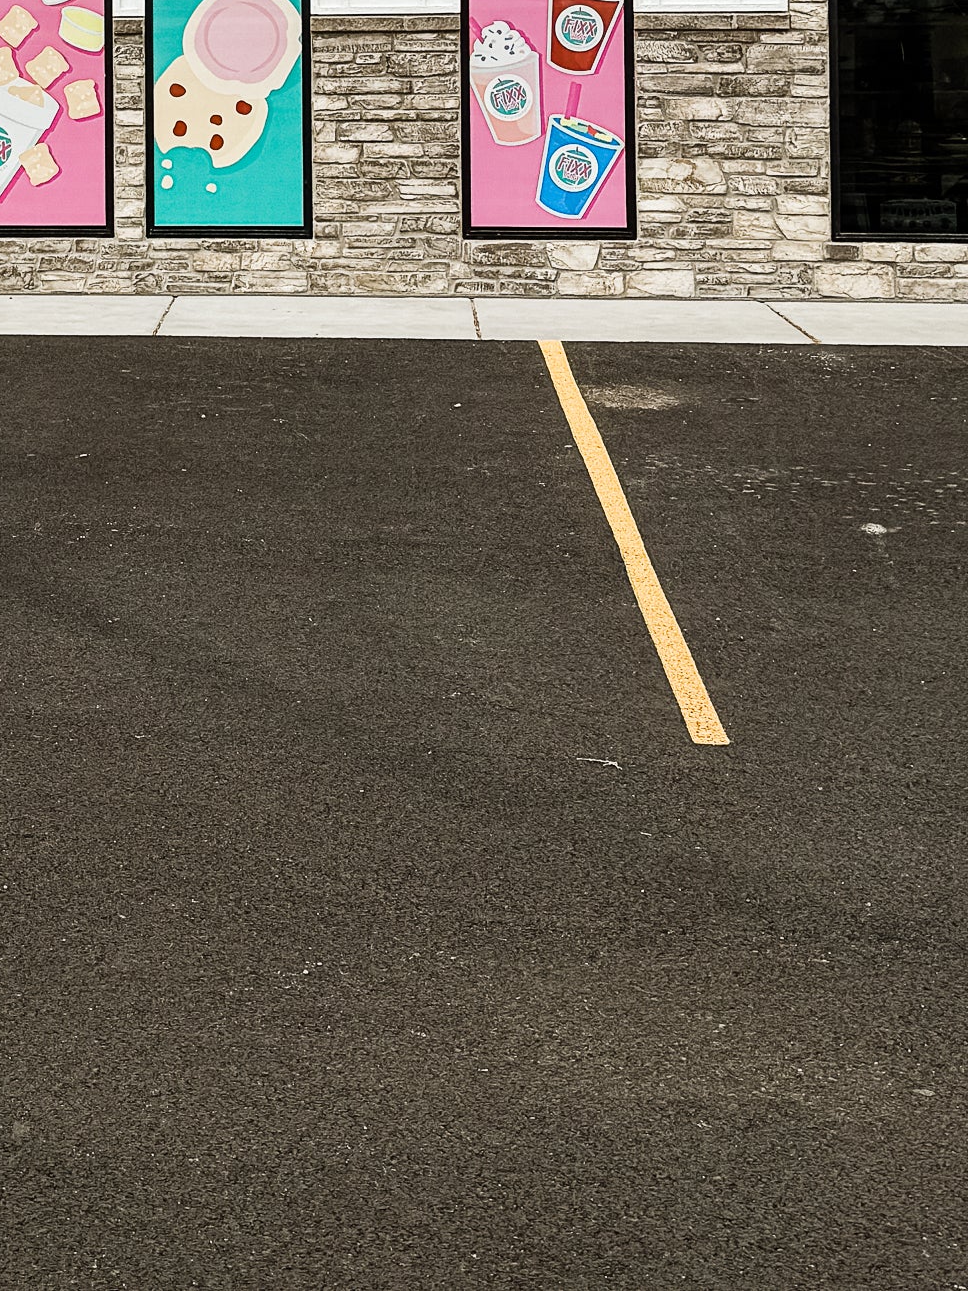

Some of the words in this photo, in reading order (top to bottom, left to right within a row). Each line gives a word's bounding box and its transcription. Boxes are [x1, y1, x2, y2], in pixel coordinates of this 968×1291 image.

[564, 18, 597, 37] FIXX
[494, 85, 525, 108] FIXX
[558, 156, 592, 178] FIXX
